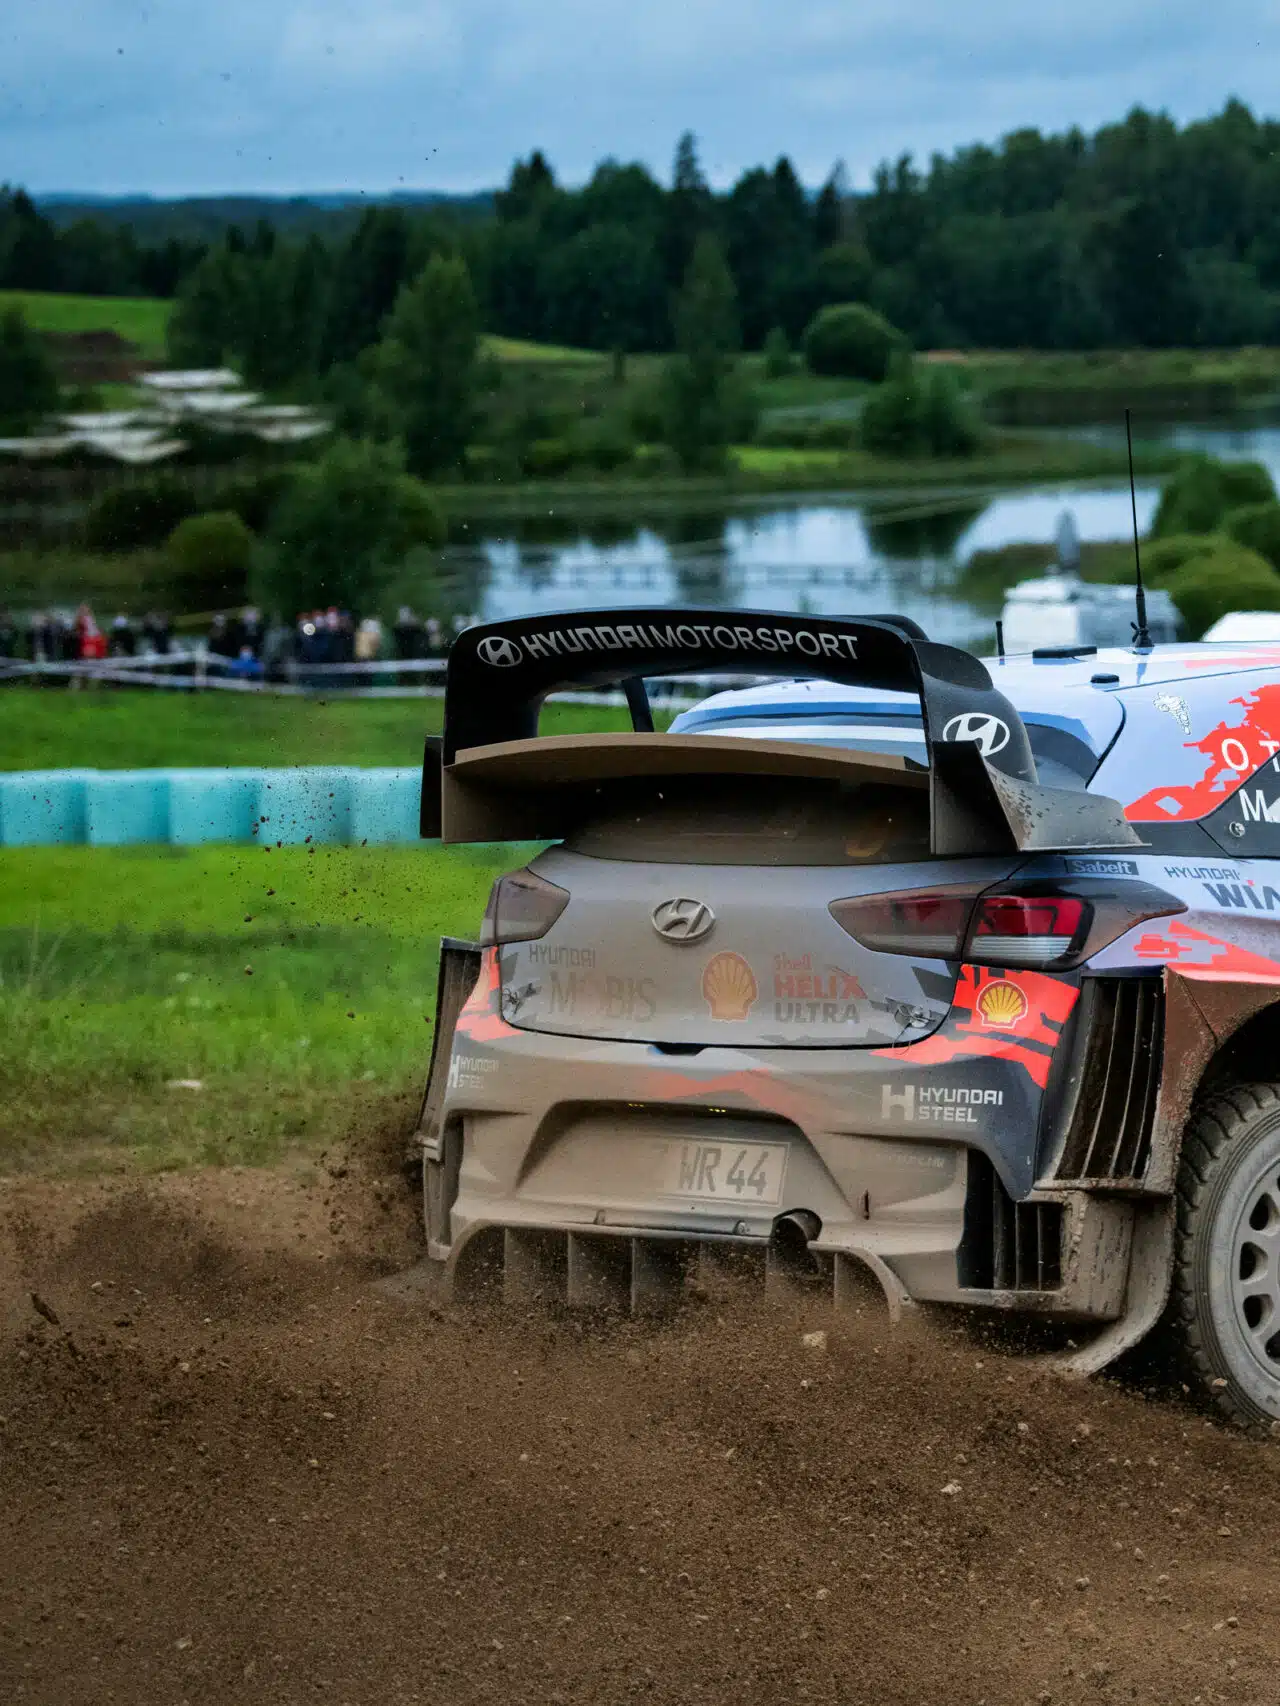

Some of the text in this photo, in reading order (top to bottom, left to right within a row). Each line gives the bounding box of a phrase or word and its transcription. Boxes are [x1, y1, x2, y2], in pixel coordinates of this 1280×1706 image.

[521, 625, 858, 660] HYUNDAI MOTORSPORT
[1221, 738, 1259, 771] O.
[1238, 788, 1275, 823] M.
[1072, 859, 1132, 876] Sabelt
[1164, 866, 1240, 881] HYUNDAI
[528, 944, 596, 969] HYUNDAI
[775, 975, 867, 999] HELIX
[775, 1002, 860, 1023] ULTRA
[919, 1087, 1003, 1106] HYUNDAI
[919, 1106, 978, 1122] STEEL
[678, 1145, 769, 1196] WR 44
